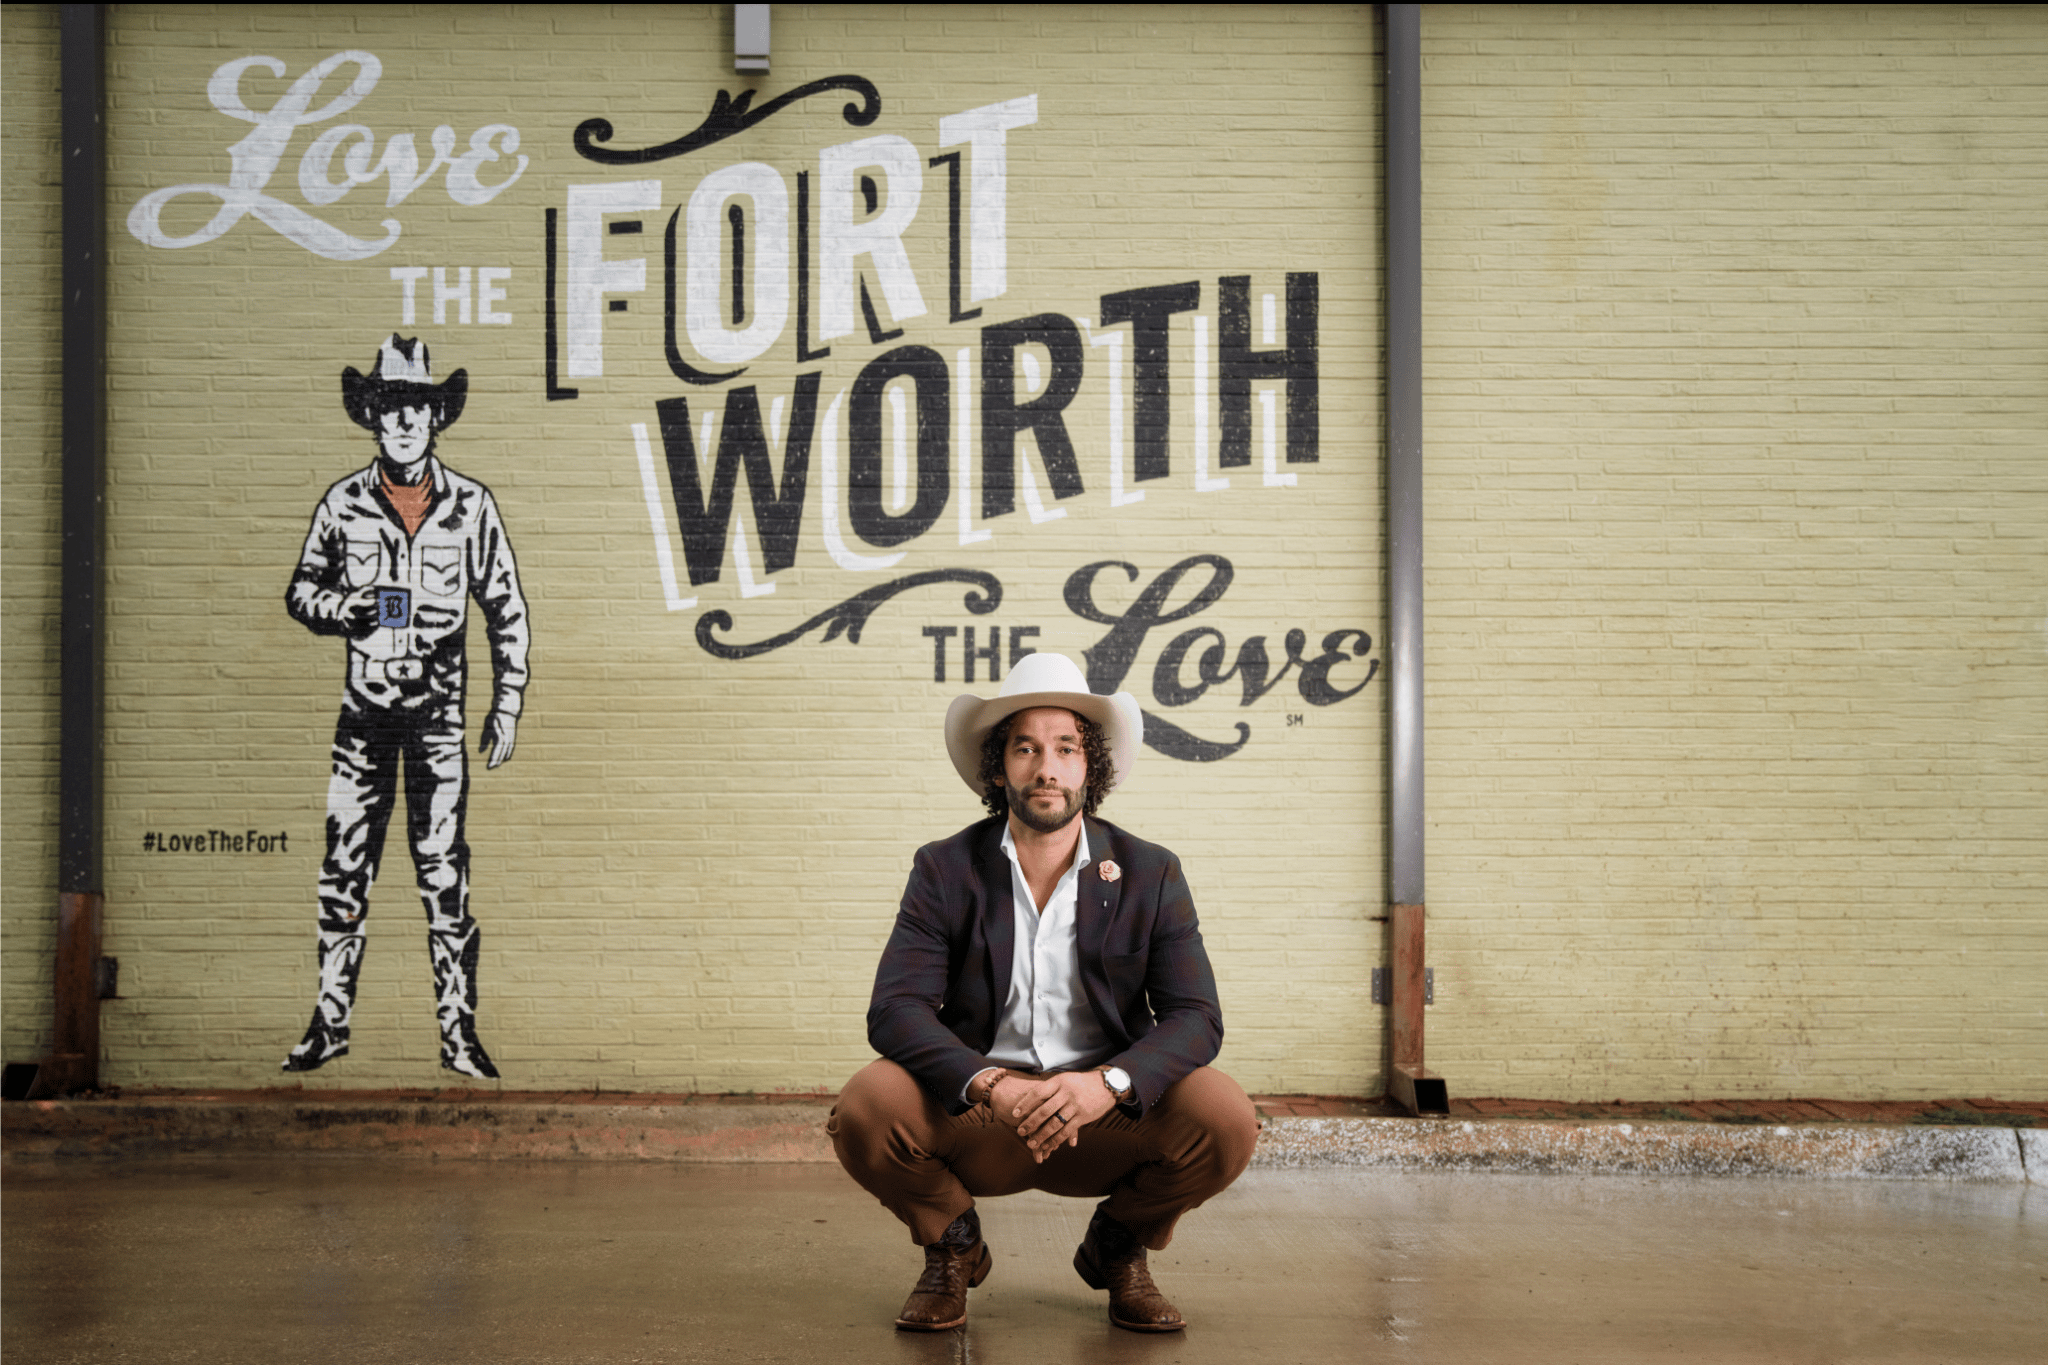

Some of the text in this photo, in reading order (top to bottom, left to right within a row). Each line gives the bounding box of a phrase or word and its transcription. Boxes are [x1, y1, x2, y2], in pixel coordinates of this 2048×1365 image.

[126, 50, 529, 261] Love
[547, 94, 1038, 401] FORT
[390, 266, 512, 325] THE
[655, 272, 1319, 586] WORTH
[1063, 554, 1380, 762] Love
[1286, 713, 1304, 727] SM
[143, 829, 288, 853] #LoveTheFort
